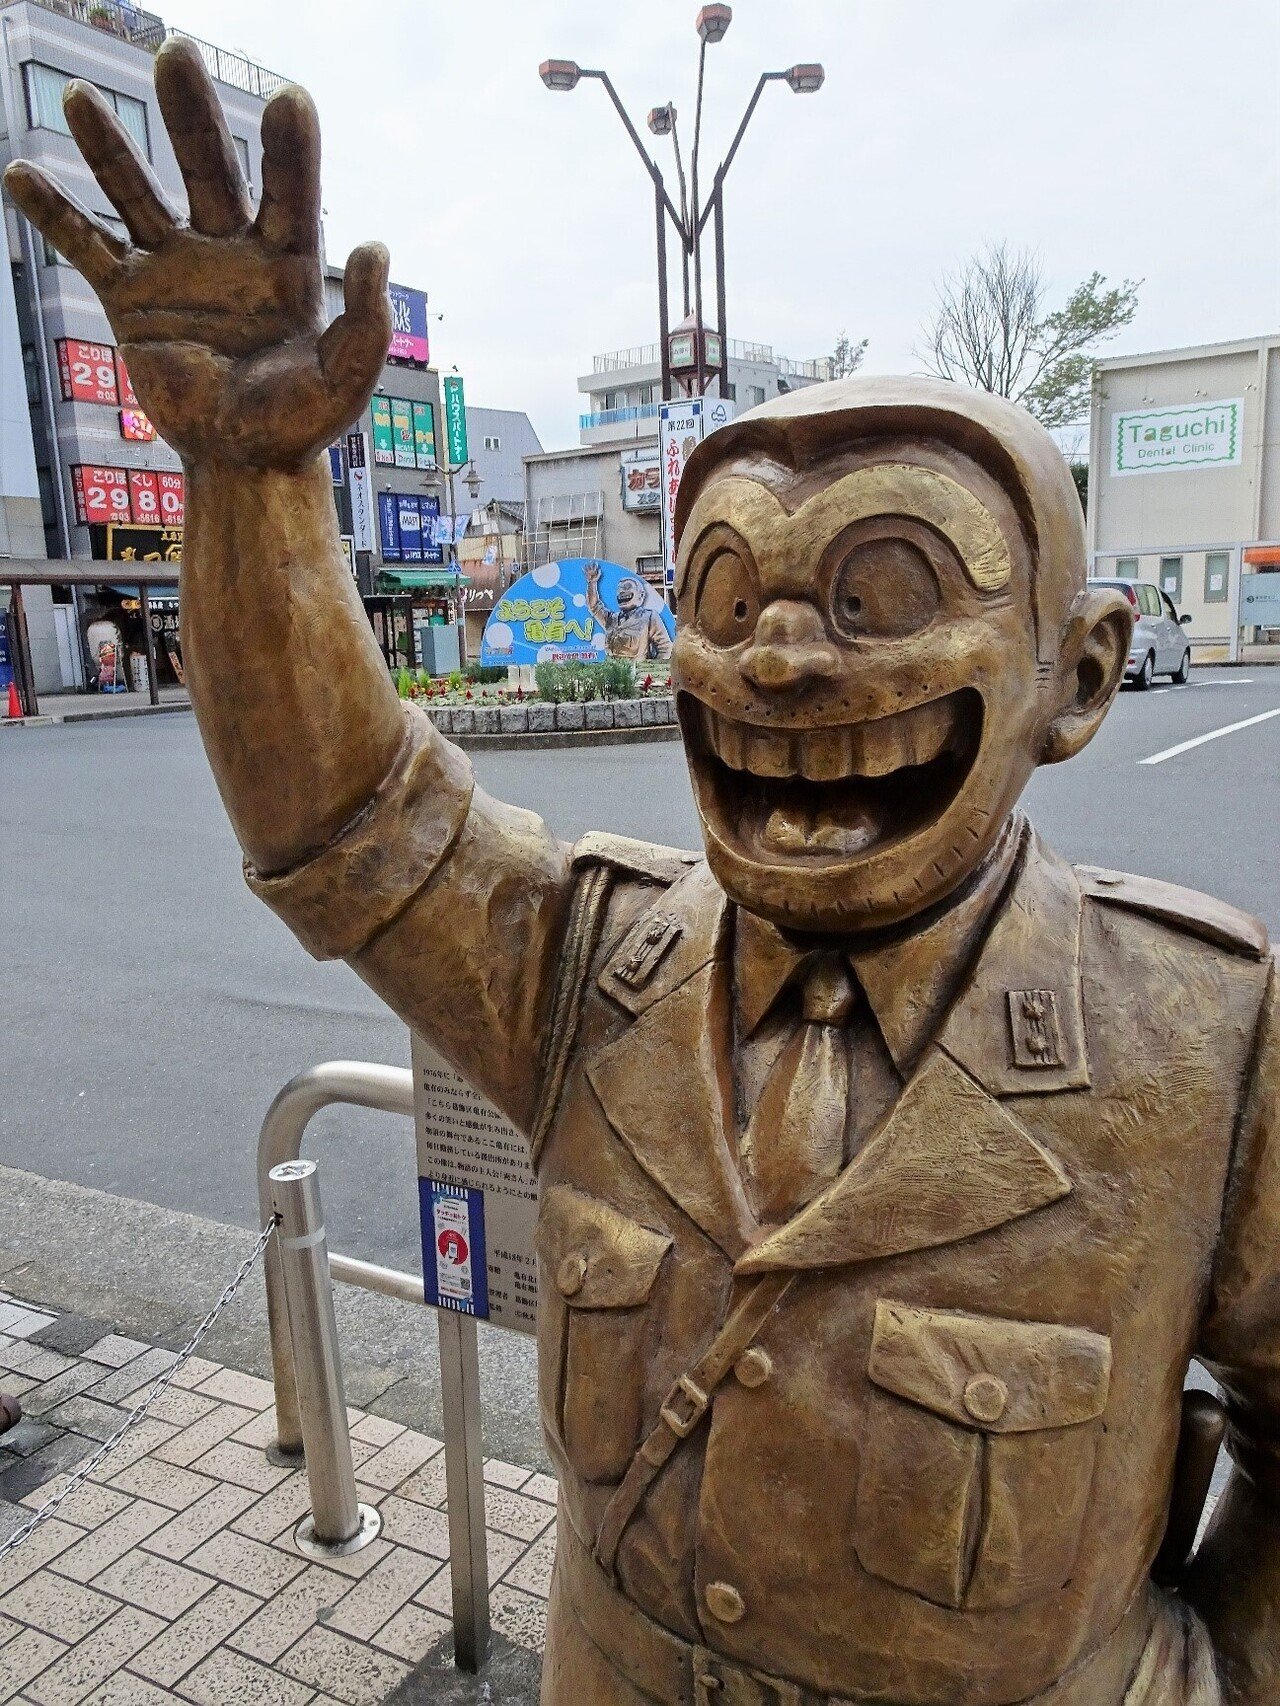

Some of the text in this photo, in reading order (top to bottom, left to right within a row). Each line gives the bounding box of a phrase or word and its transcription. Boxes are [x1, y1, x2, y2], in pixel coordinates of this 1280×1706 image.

[1128, 415, 1225, 443] Taguchi
[1138, 442, 1215, 458] Dental Clinic
[496, 598, 565, 622] ようこそ
